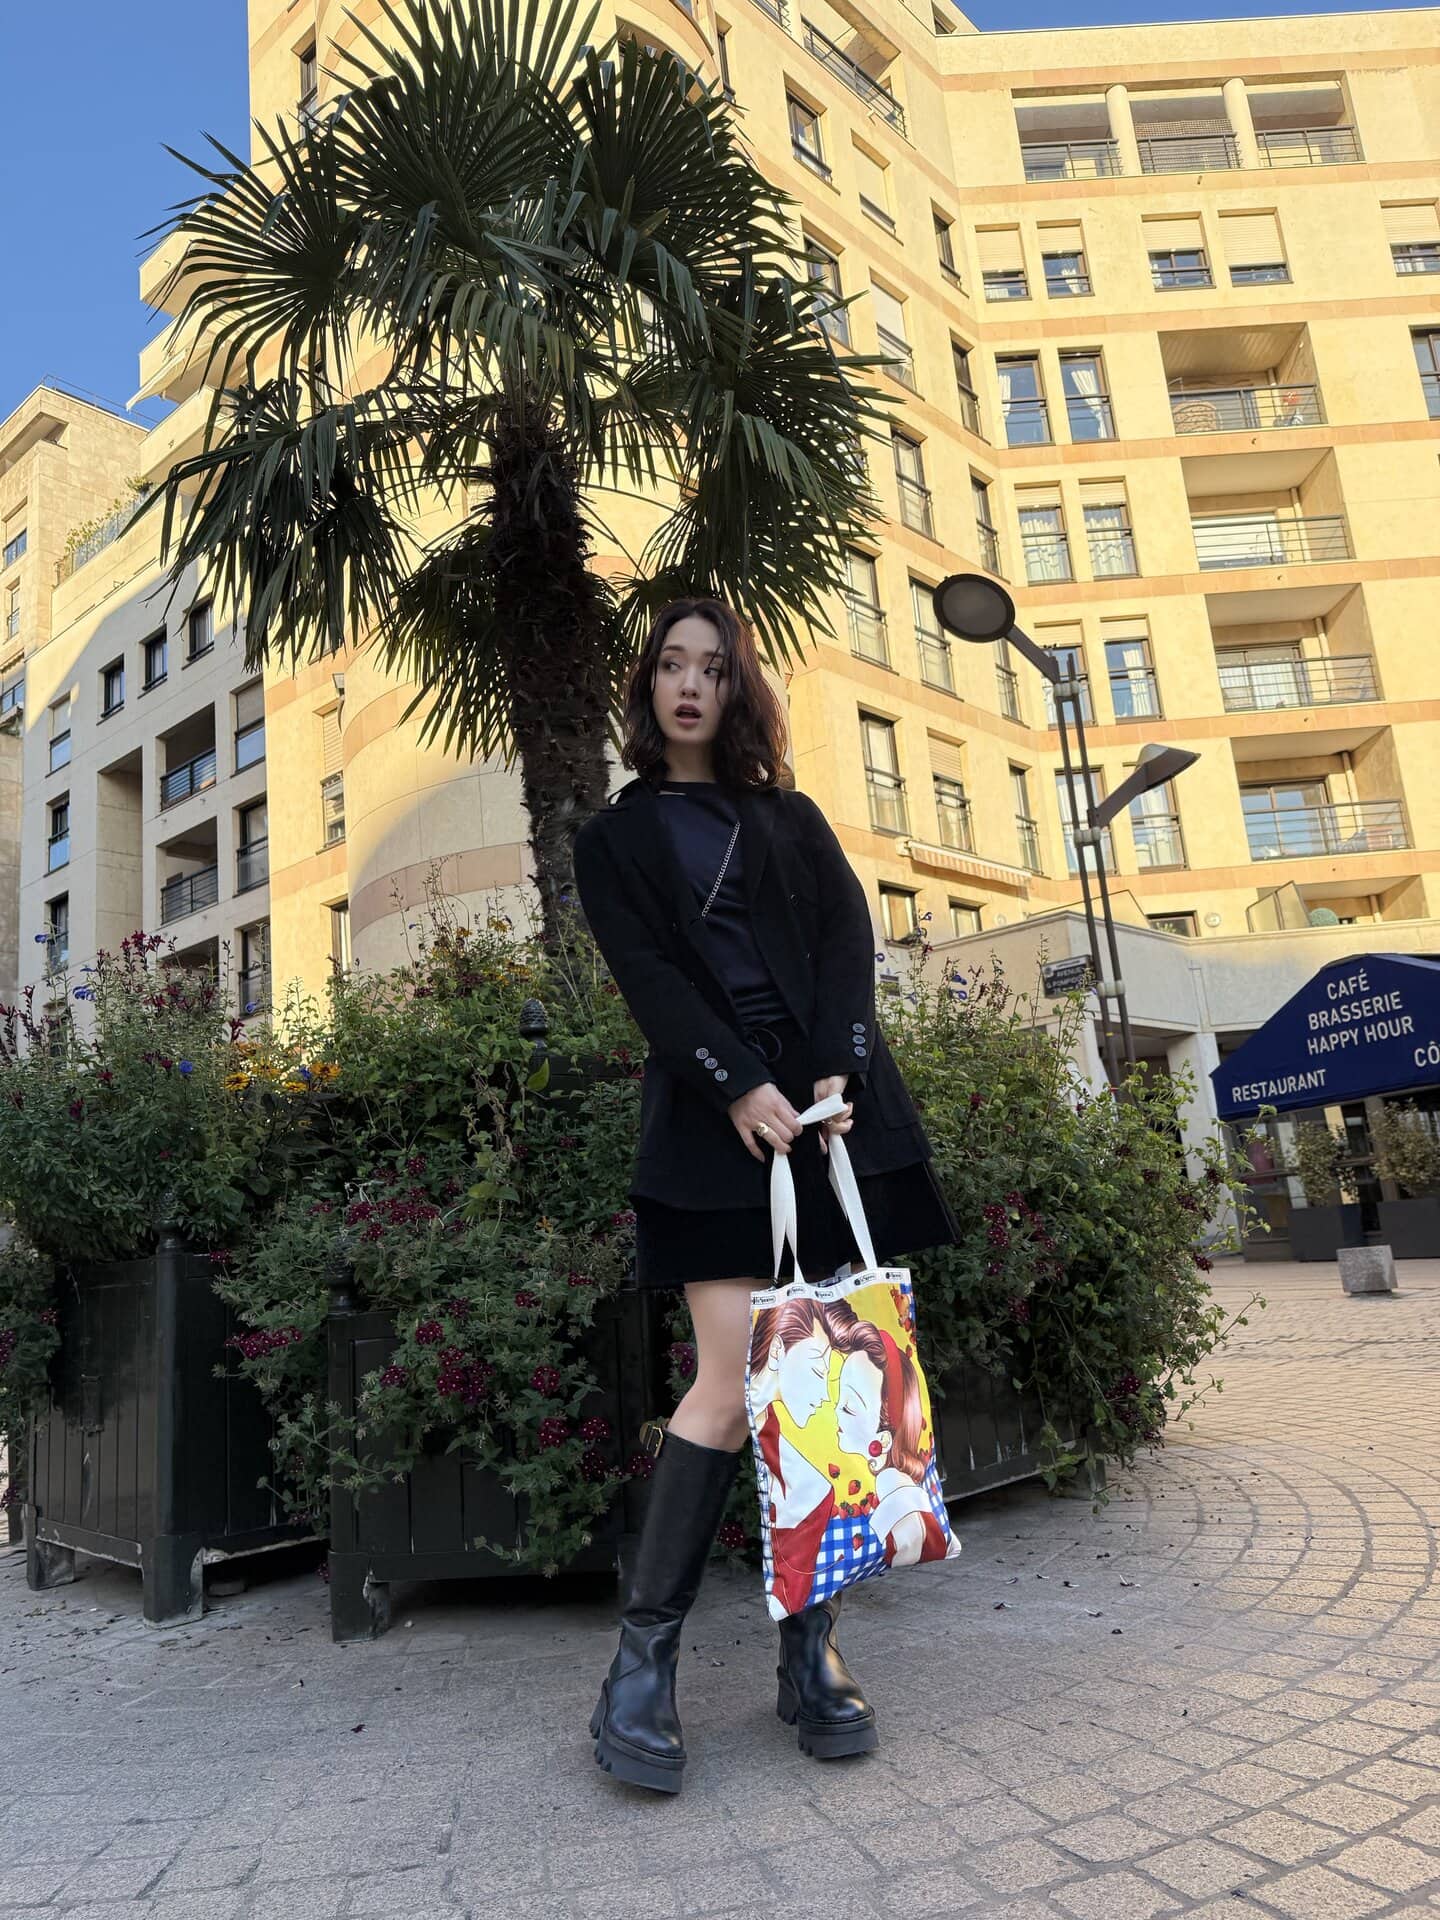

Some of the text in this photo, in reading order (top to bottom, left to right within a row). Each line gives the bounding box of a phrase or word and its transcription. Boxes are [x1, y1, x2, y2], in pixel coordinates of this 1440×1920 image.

[1327, 968, 1370, 1000] CAFÉ
[1308, 991, 1403, 1031] BRASSERIE
[1307, 1015, 1415, 1055] HAPPY HOUR
[1414, 1040, 1440, 1067] CÔ
[1232, 1069, 1326, 1103] RESTAURANT
